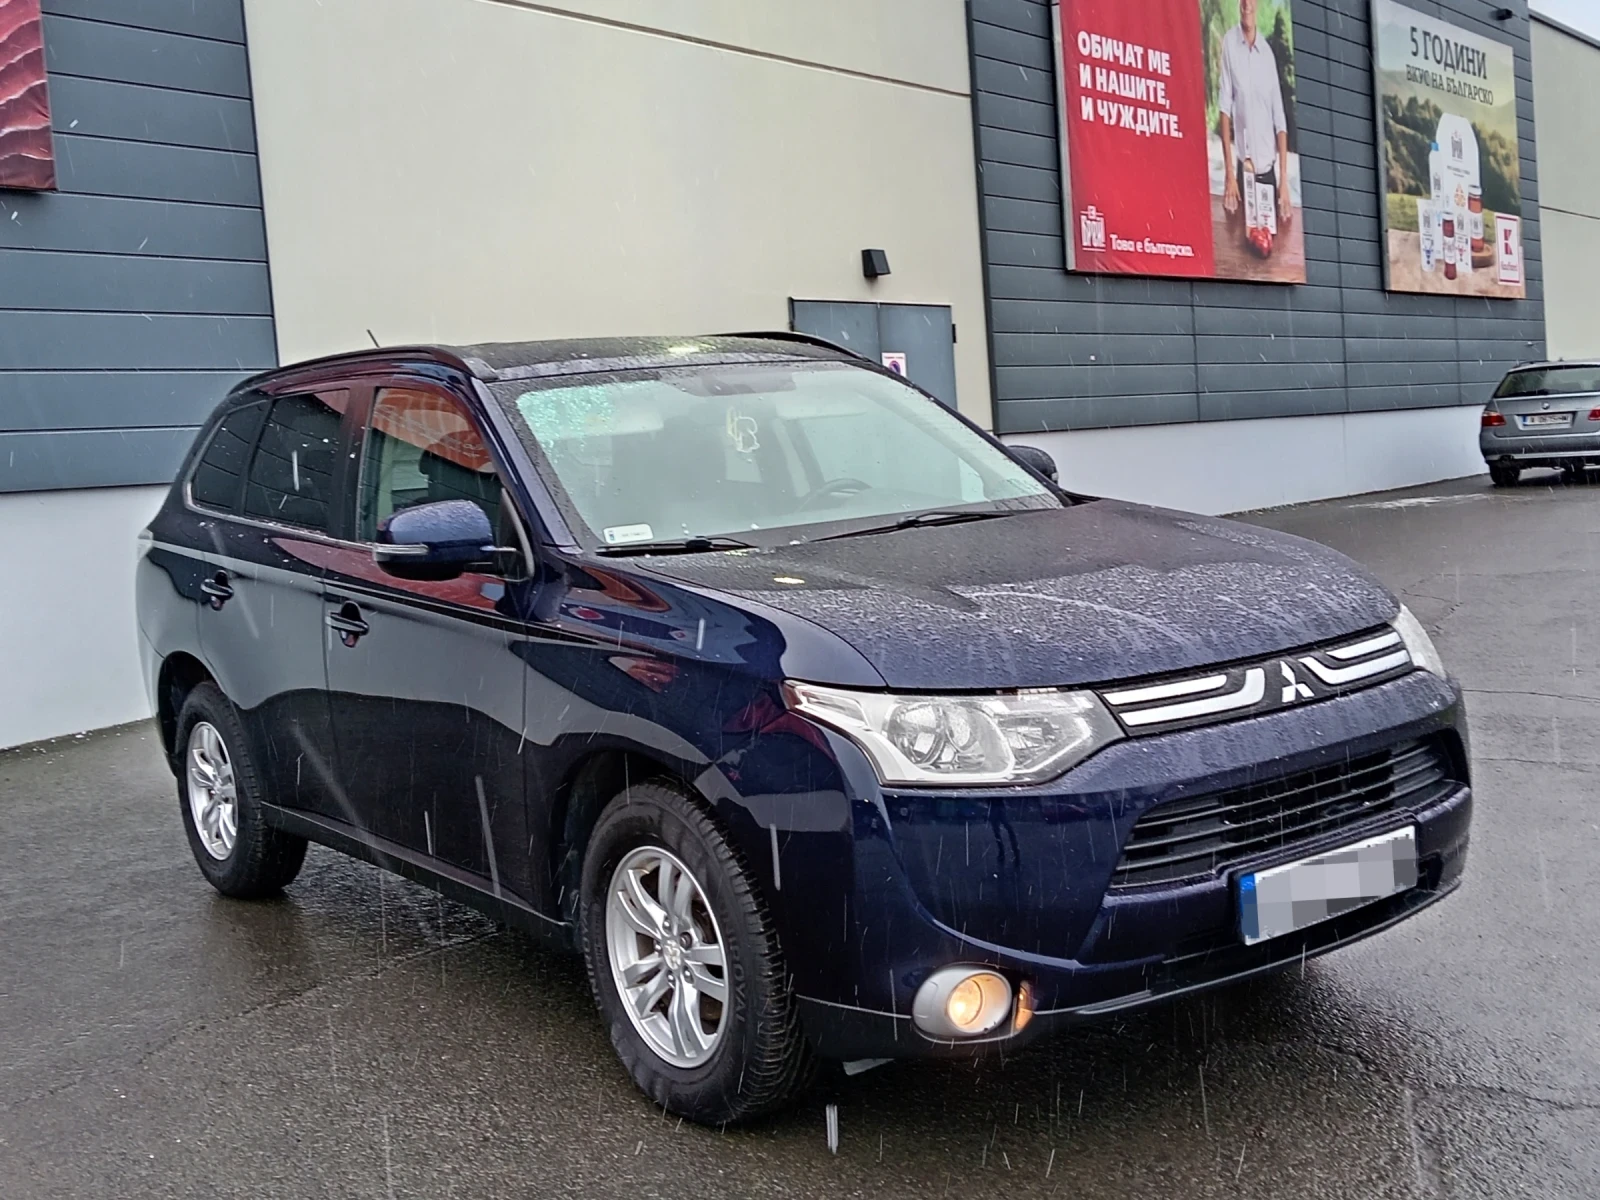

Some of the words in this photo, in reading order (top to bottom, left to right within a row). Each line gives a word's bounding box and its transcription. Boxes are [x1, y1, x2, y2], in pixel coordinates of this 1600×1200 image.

[1077, 30, 1144, 69] ОБИЧАТ
[1147, 48, 1171, 77] МЕ
[1410, 26, 1419, 57] 5
[1422, 30, 1487, 80] ГОДИНИ
[1079, 62, 1092, 89] И
[1095, 66, 1170, 110] НАШИТЕ,
[1406, 64, 1430, 87] ВКУС
[1431, 72, 1445, 91] НА
[1446, 76, 1494, 106] БЪЛГАРСКО
[1081, 95, 1095, 122] И
[1096, 98, 1183, 139] ЧУЖДИТЕ.
[1109, 233, 1136, 252] Това
[1136, 241, 1144, 253] е
[1503, 228, 1514, 256] K
